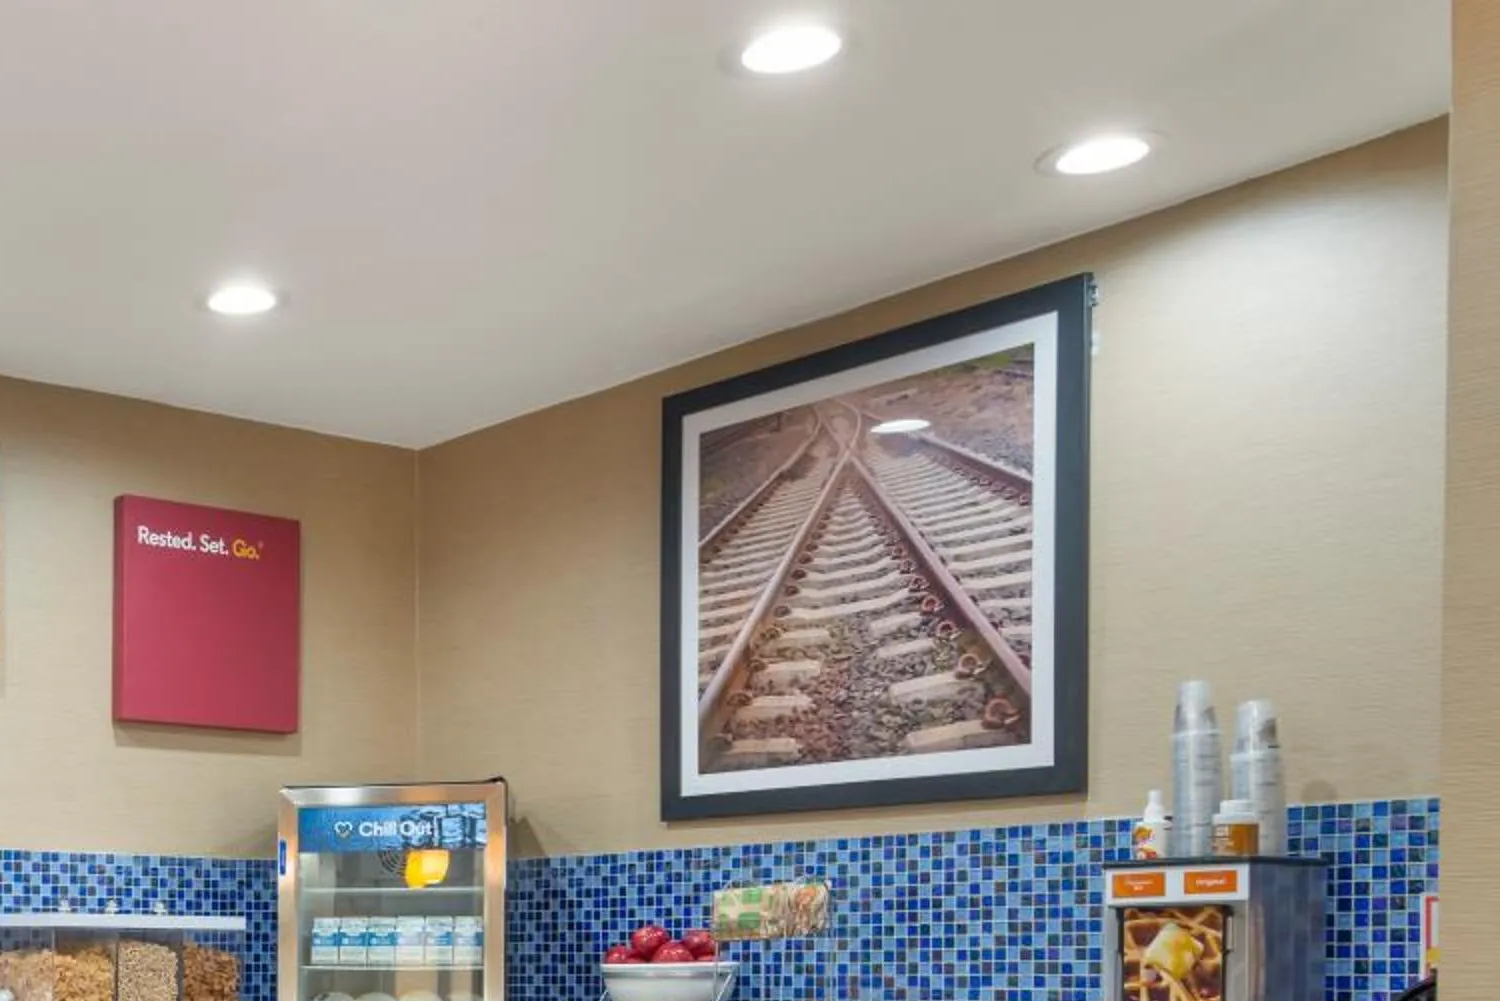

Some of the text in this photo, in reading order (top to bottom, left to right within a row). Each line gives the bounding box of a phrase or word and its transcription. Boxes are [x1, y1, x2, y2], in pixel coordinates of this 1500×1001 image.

[137, 525, 261, 561] Rested. Set. Go.
[358, 820, 433, 837] Chill Out
